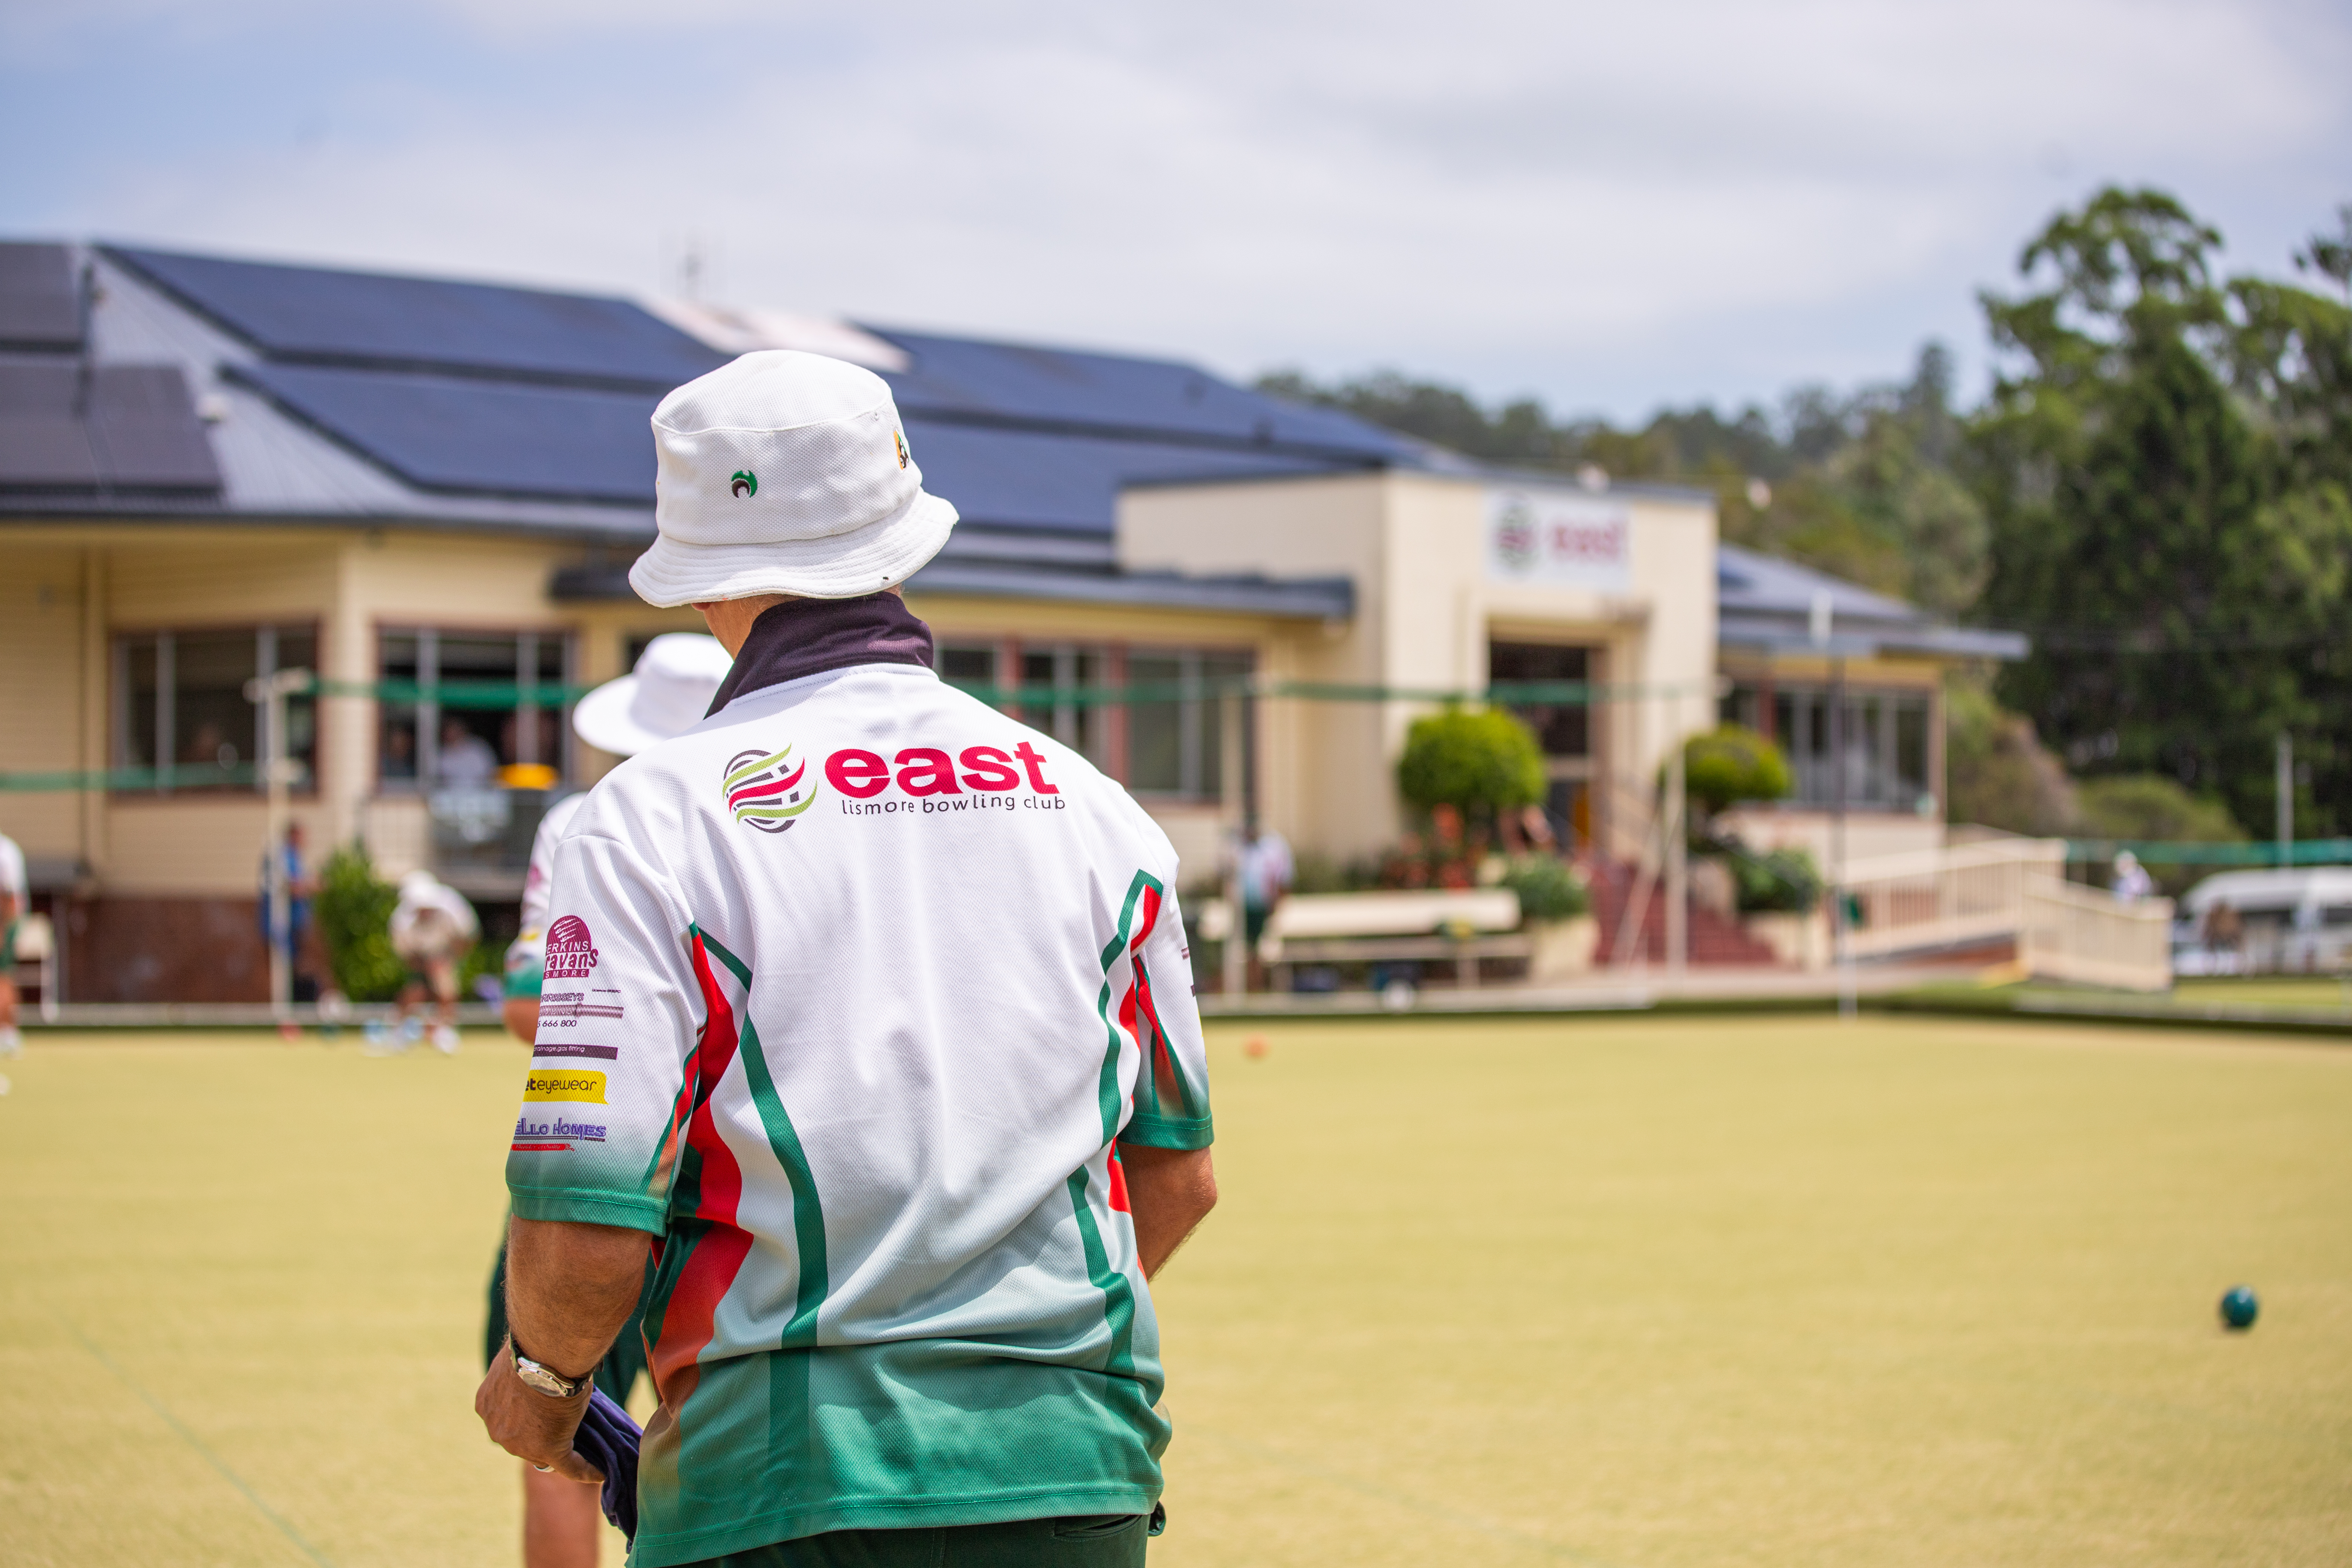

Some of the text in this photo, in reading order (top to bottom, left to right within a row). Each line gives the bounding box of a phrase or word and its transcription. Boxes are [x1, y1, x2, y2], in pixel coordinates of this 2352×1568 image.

[825, 741, 1060, 798] east
[842, 794, 1066, 815] lismore bowling club
[546, 941, 588, 954] ERKINS
